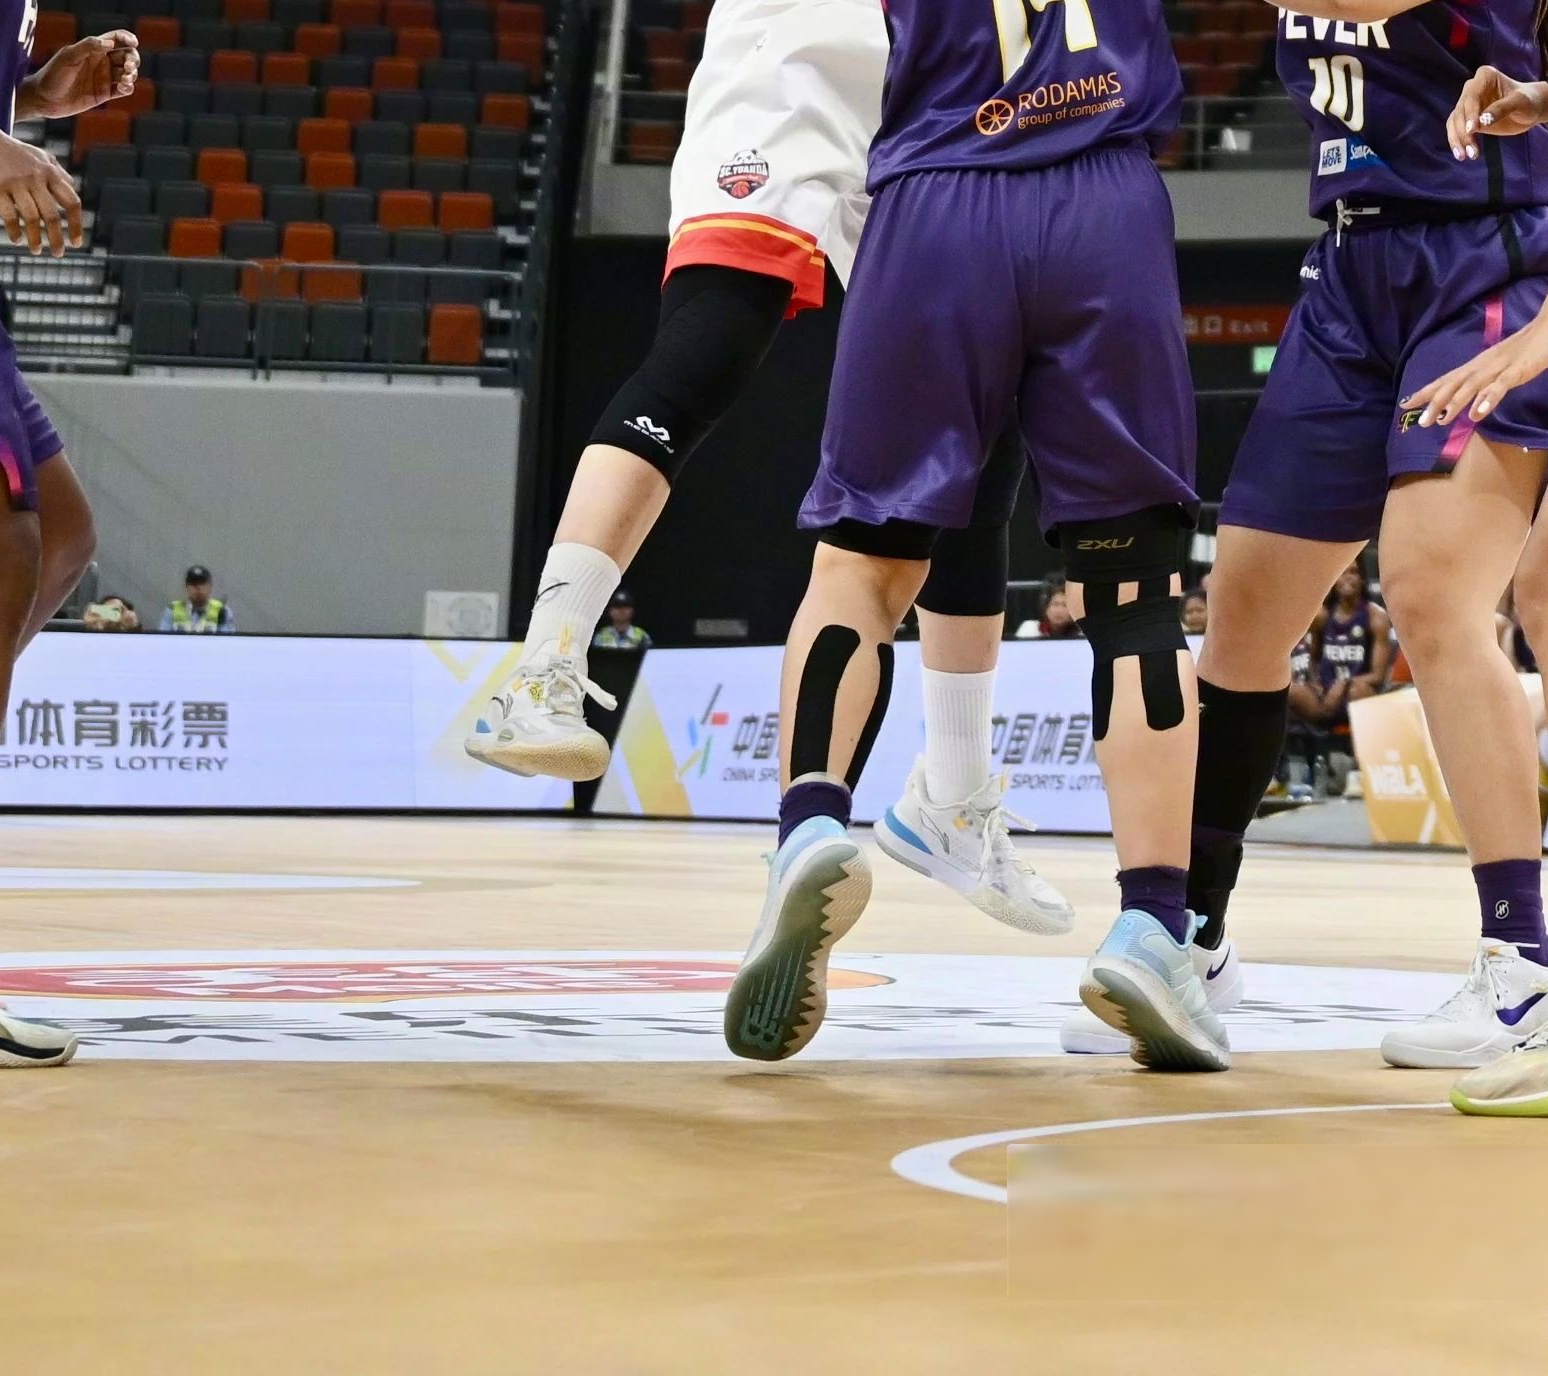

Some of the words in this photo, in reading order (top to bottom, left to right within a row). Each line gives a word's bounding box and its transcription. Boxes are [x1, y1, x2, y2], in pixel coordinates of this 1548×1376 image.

[1018, 71, 1122, 113] RODAMAS
[1308, 54, 1365, 132] 10
[1017, 113, 1053, 130] group
[1055, 106, 1068, 120] of
[1069, 96, 1126, 120] companies
[1077, 535, 1135, 550] 2XU
[113, 755, 229, 773] LOTTERY
